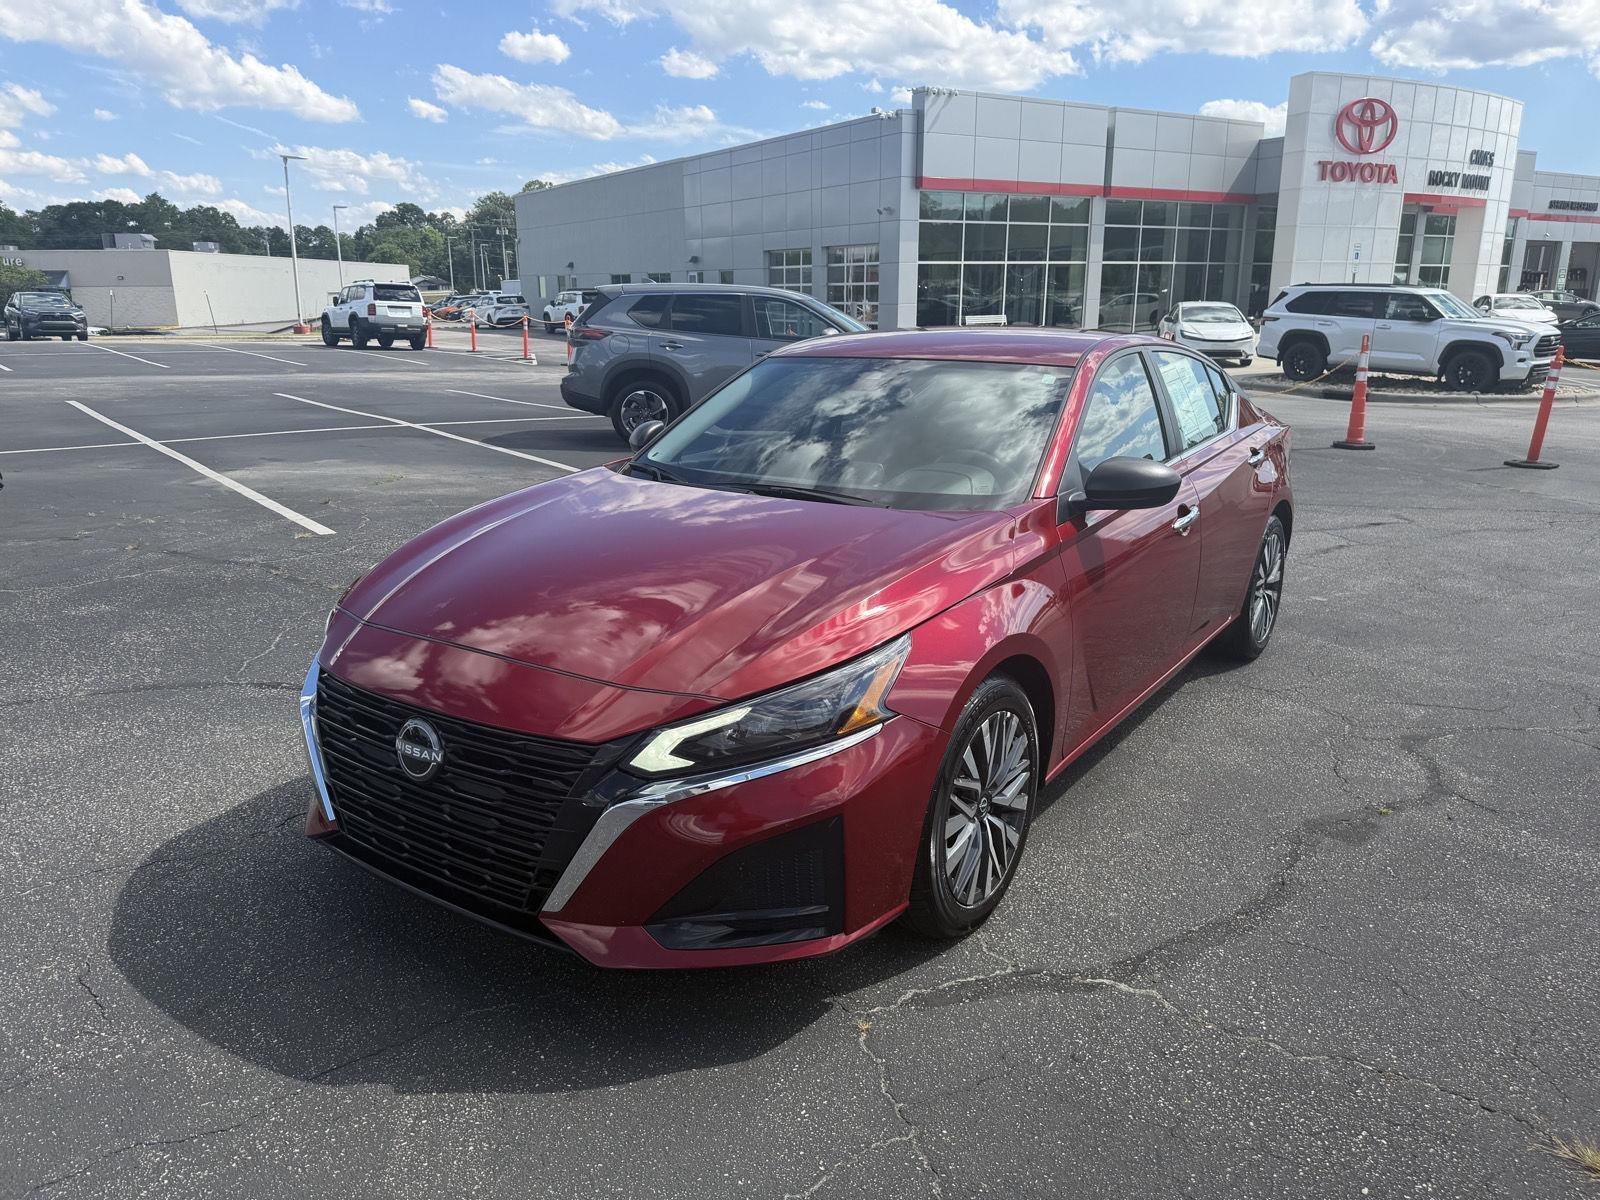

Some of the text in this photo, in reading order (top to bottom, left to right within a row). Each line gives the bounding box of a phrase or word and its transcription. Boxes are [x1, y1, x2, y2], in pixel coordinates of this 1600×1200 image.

[1318, 160, 1399, 184] TOYOTA
[1427, 170, 1492, 191] ROCKY MOUNT
[395, 738, 442, 762] NISSAN
